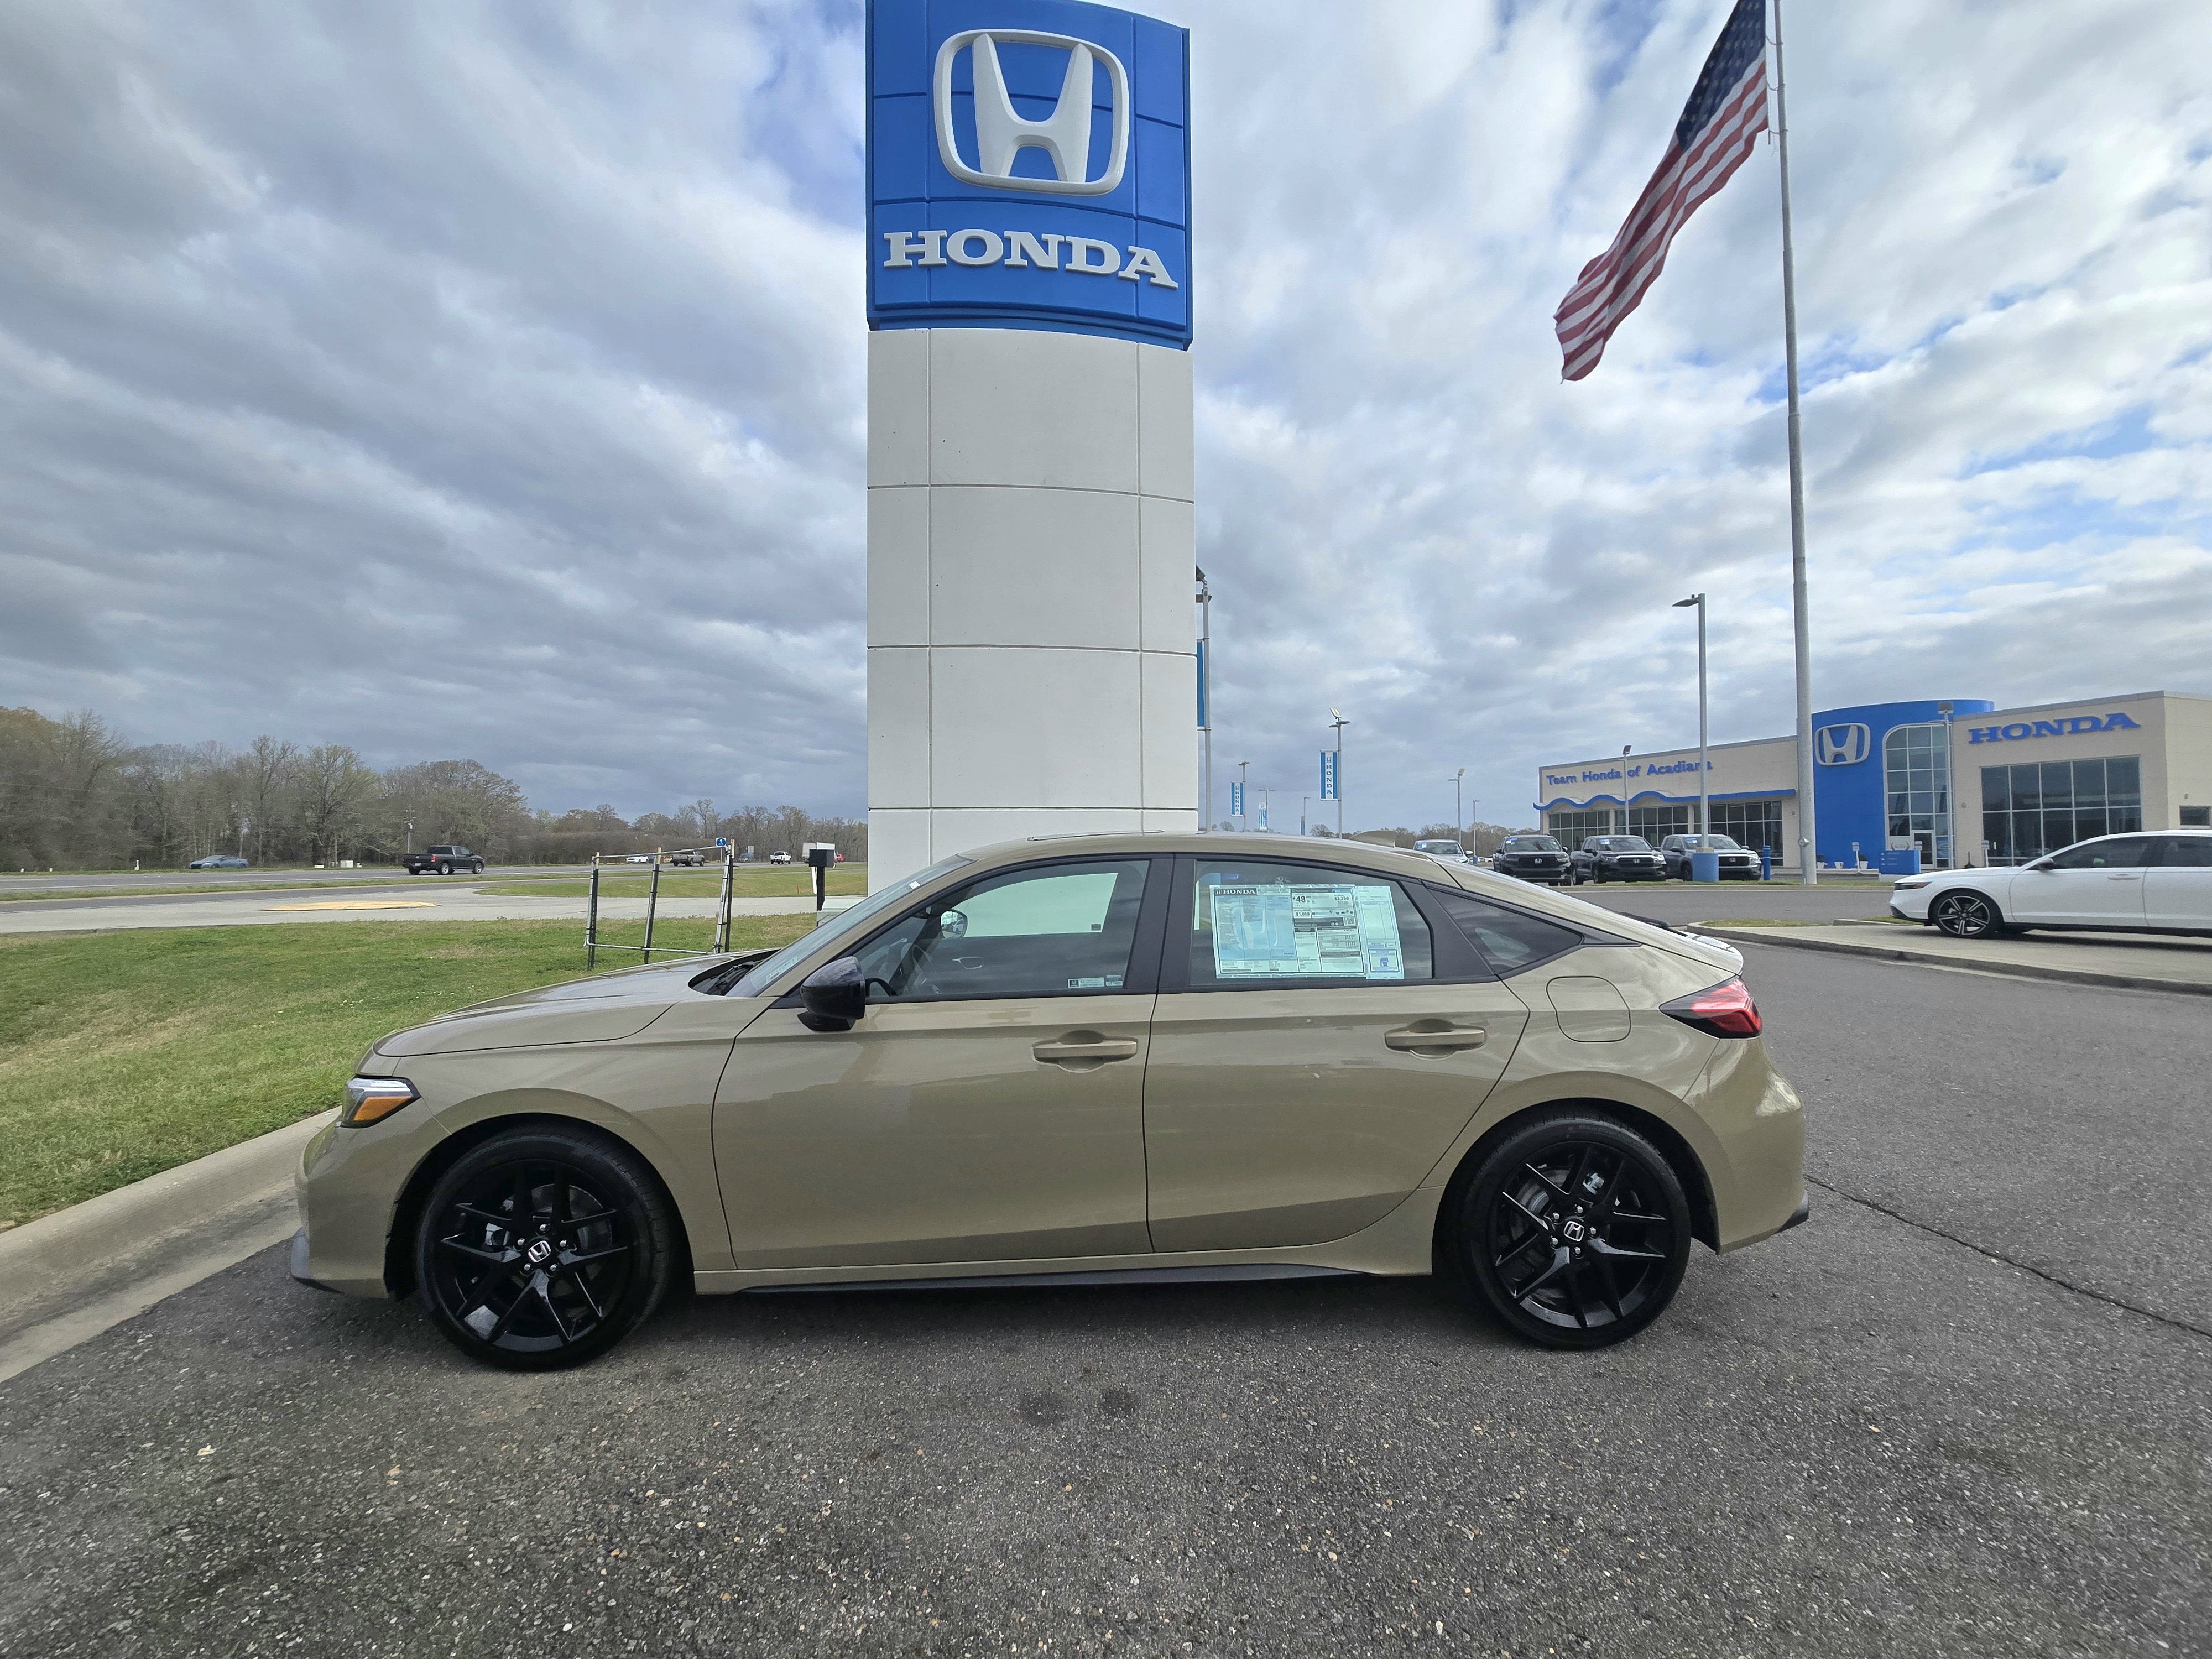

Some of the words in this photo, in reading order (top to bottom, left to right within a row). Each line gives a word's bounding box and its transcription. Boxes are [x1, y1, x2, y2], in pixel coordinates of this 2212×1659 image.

[883, 228, 1178, 290] HONDA
[1968, 712, 2141, 744] HONDA
[1546, 775, 1578, 785] Team
[1582, 768, 1623, 782] Honda
[1627, 765, 1642, 777] of
